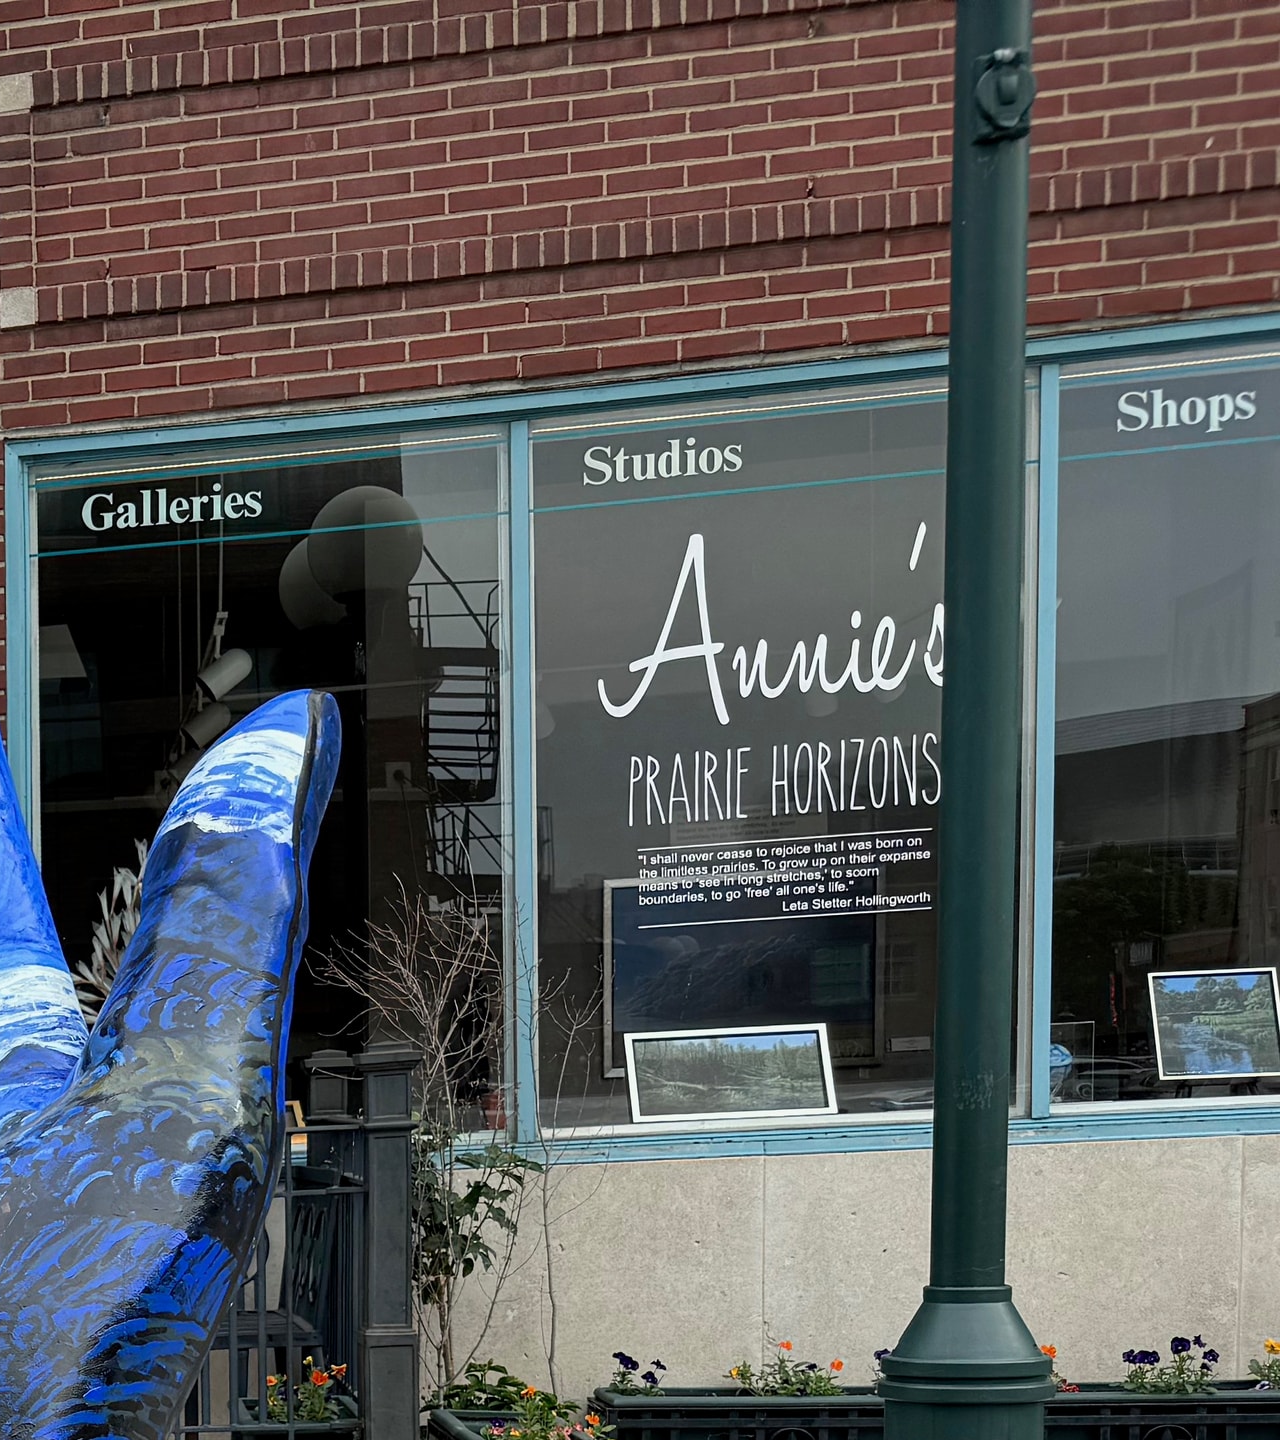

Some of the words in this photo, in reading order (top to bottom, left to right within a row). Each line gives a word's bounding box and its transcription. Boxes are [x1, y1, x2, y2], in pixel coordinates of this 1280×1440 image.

[1116, 388, 1257, 433] Shops
[582, 437, 744, 486] Studios
[80, 482, 264, 532] Galleries
[627, 746, 752, 827] PRAIRIE
[770, 732, 942, 817] HORIZONS
[639, 868, 658, 879] the
[661, 865, 708, 878] limitless
[711, 861, 759, 876] prairies.
[761, 859, 776, 870] To
[779, 858, 809, 872] grow
[812, 857, 827, 869] up
[830, 855, 846, 866] on
[849, 852, 876, 865] their
[879, 850, 931, 864] expanse
[650, 852, 678, 866] shall
[681, 852, 714, 863] never
[717, 849, 753, 860] cease
[756, 847, 768, 858] to
[771, 844, 811, 858] rejoice
[814, 842, 838, 853] that
[847, 840, 872, 851] was
[875, 838, 903, 849] born
[906, 837, 923, 848] on
[638, 881, 678, 893] means
[681, 879, 693, 890] to
[723, 875, 735, 887] in
[737, 874, 763, 887] long
[830, 868, 843, 879] to
[845, 867, 880, 878] scorn
[638, 891, 708, 906] boundaries,
[711, 890, 723, 901] to
[725, 890, 741, 902] go
[775, 884, 790, 896] all
[792, 882, 825, 895] one's
[782, 900, 809, 912] Leta
[811, 897, 853, 910] Stetter
[855, 891, 932, 907] Hollingworth
